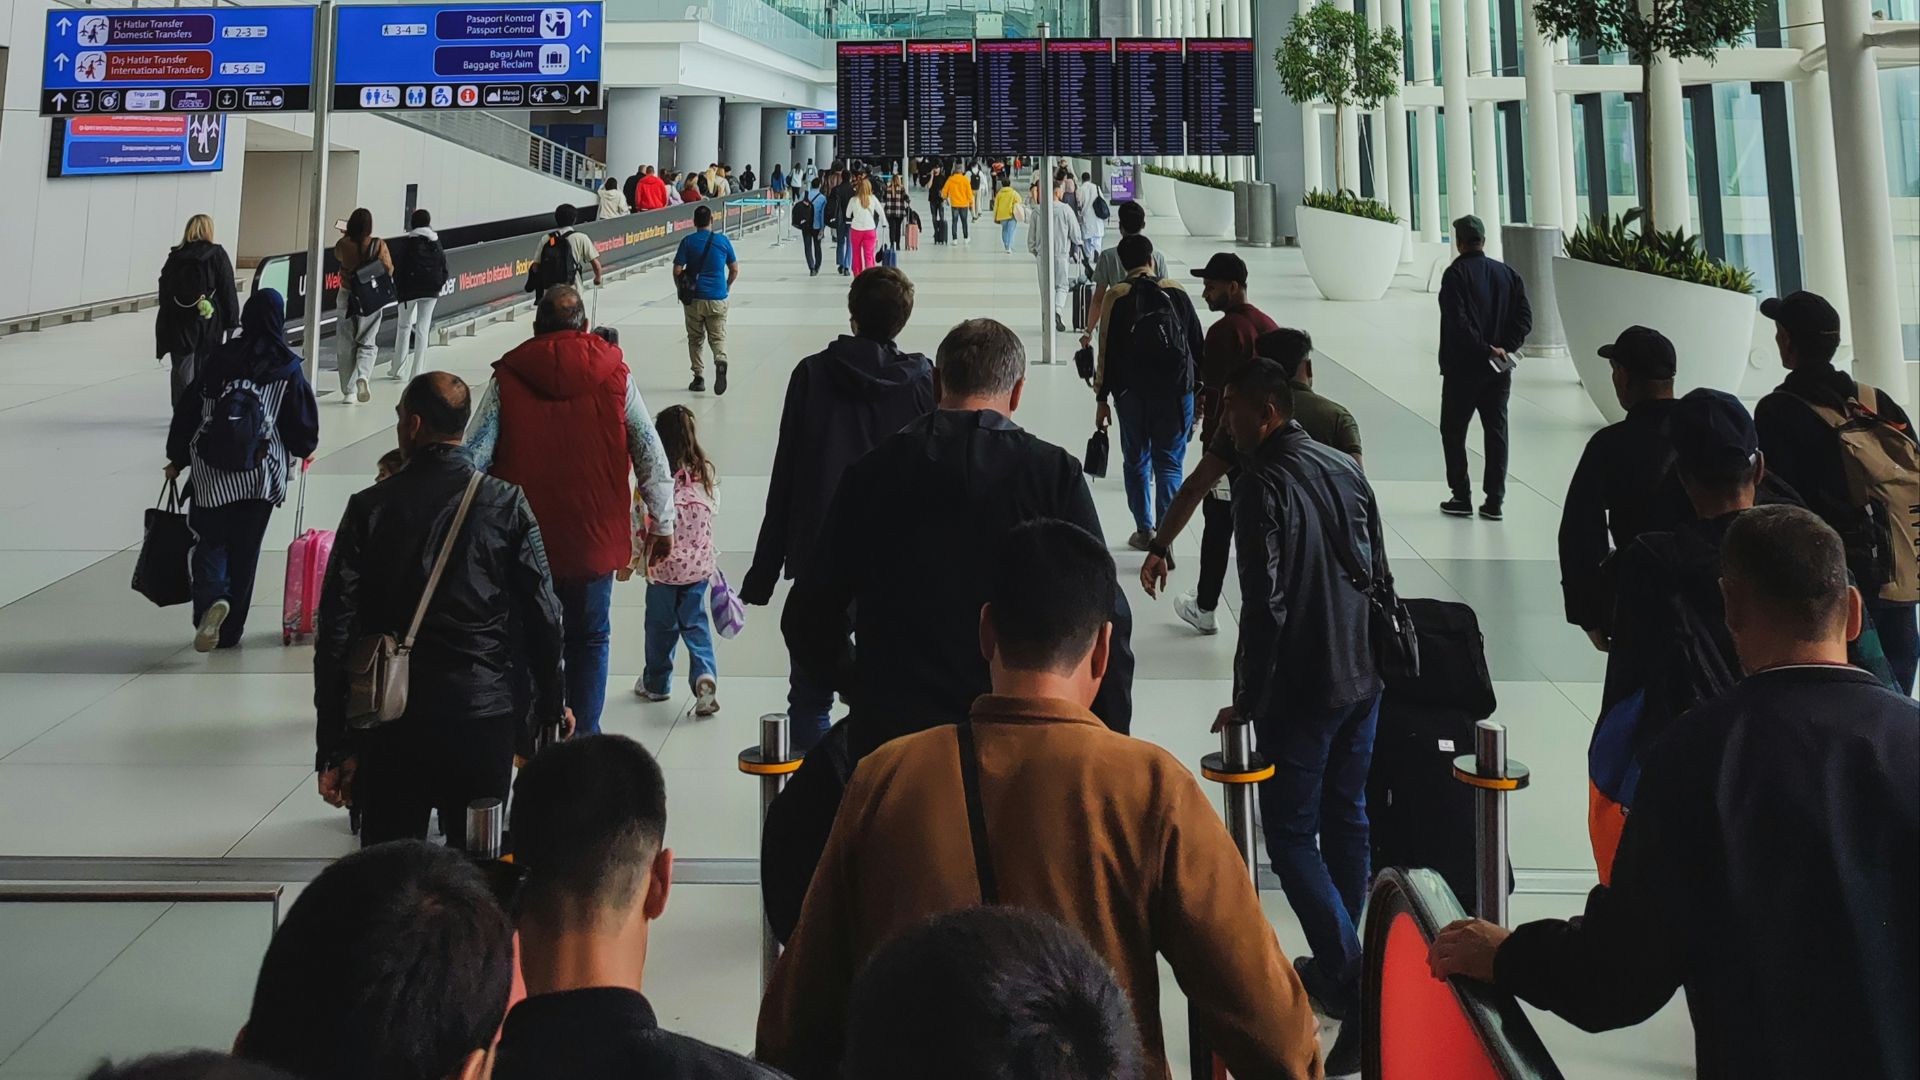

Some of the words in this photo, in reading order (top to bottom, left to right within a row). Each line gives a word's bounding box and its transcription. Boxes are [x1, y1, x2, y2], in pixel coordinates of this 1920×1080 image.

[114, 19, 122, 30] İç
[123, 19, 149, 29] Hatlar
[151, 19, 184, 29] Transfer
[466, 15, 503, 25] Pasaport
[504, 13, 535, 23] Kontrol
[113, 30, 154, 39] Domestic
[155, 29, 193, 38] Transfers
[235, 27, 252, 37] 2-3
[395, 25, 412, 35] 3-4
[466, 26, 502, 36] Passport
[503, 24, 535, 34] Control
[127, 55, 152, 64] Hatlar
[154, 54, 188, 64] Transfer
[490, 49, 513, 60] Bagaj
[111, 66, 166, 75] International
[167, 65, 205, 74] Transfers
[233, 63, 250, 74] 5-6
[463, 60, 500, 71] Baggage
[501, 59, 534, 69] Reclaim
[459, 271, 486, 291] Welcome
[493, 262, 513, 282] Istanbul
